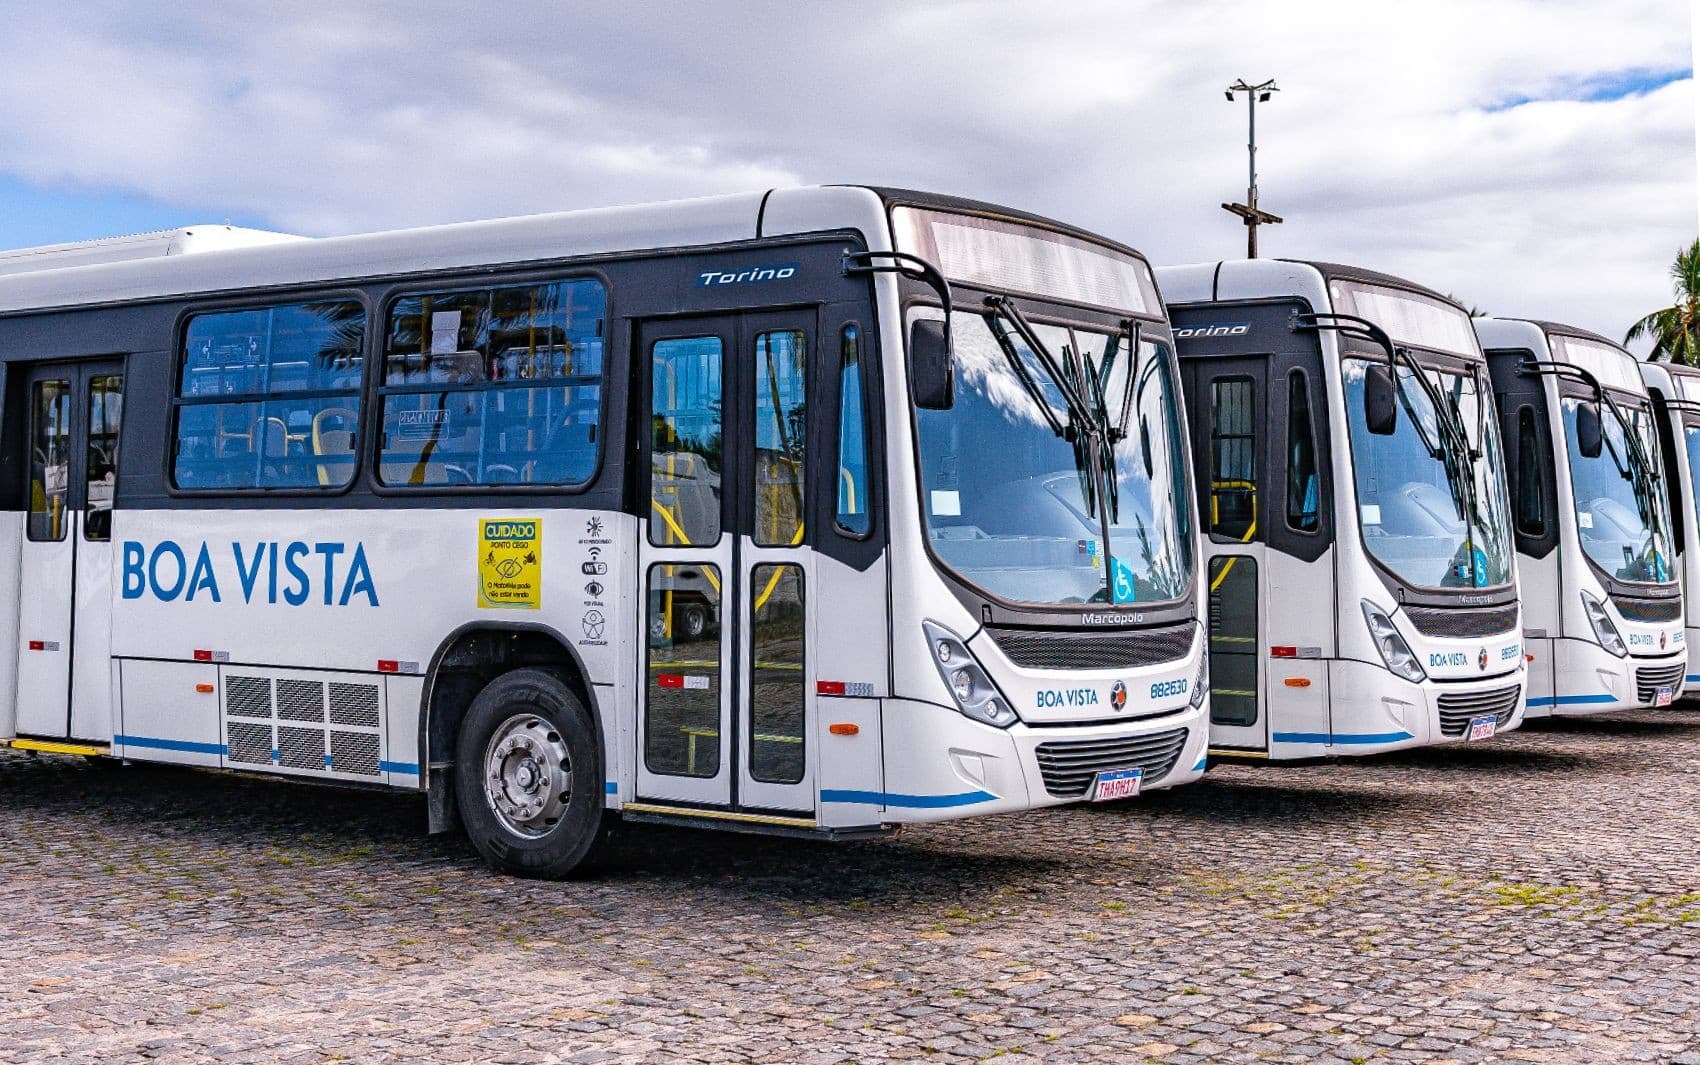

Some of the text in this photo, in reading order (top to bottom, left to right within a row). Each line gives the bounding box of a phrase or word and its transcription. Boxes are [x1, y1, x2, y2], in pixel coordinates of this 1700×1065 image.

[700, 268, 795, 285] Torino
[486, 524, 535, 538] CUIDADO
[490, 541, 511, 549] PONTO
[121, 540, 381, 607] BOA VISTA
[1082, 612, 1144, 625] Marcopolo
[1429, 652, 1468, 667] BOA VISTA
[1150, 678, 1188, 699] 882630
[1037, 688, 1099, 708] BOA VISTA
